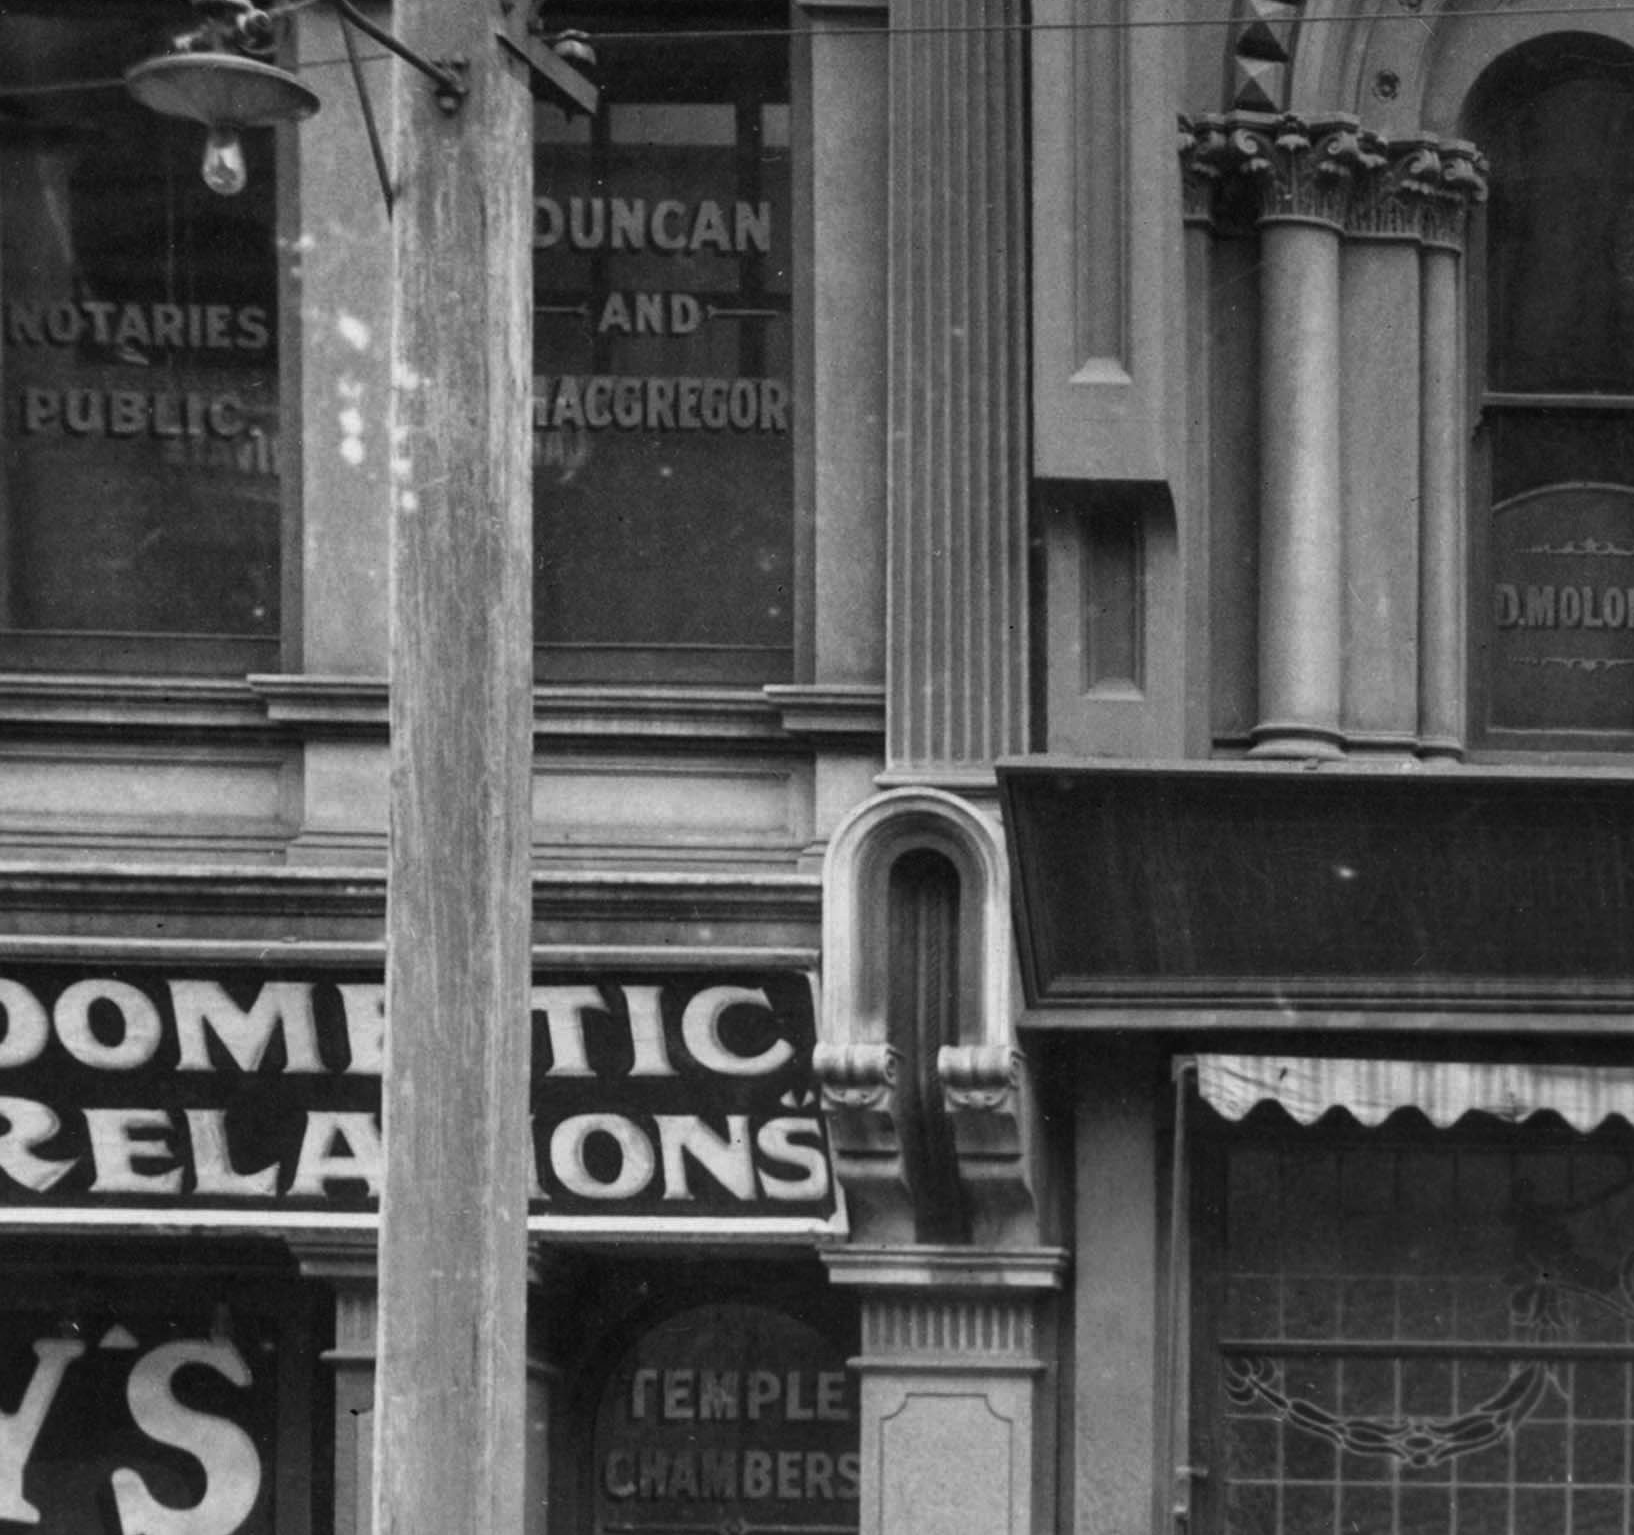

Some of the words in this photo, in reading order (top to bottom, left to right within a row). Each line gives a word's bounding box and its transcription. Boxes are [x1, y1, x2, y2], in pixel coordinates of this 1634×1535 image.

[8, 298, 270, 352] NOTARIES
[601, 293, 703, 336] AND
[632, 1369, 852, 1421] TEMPLE
[605, 1449, 859, 1499] CHAMBERS
